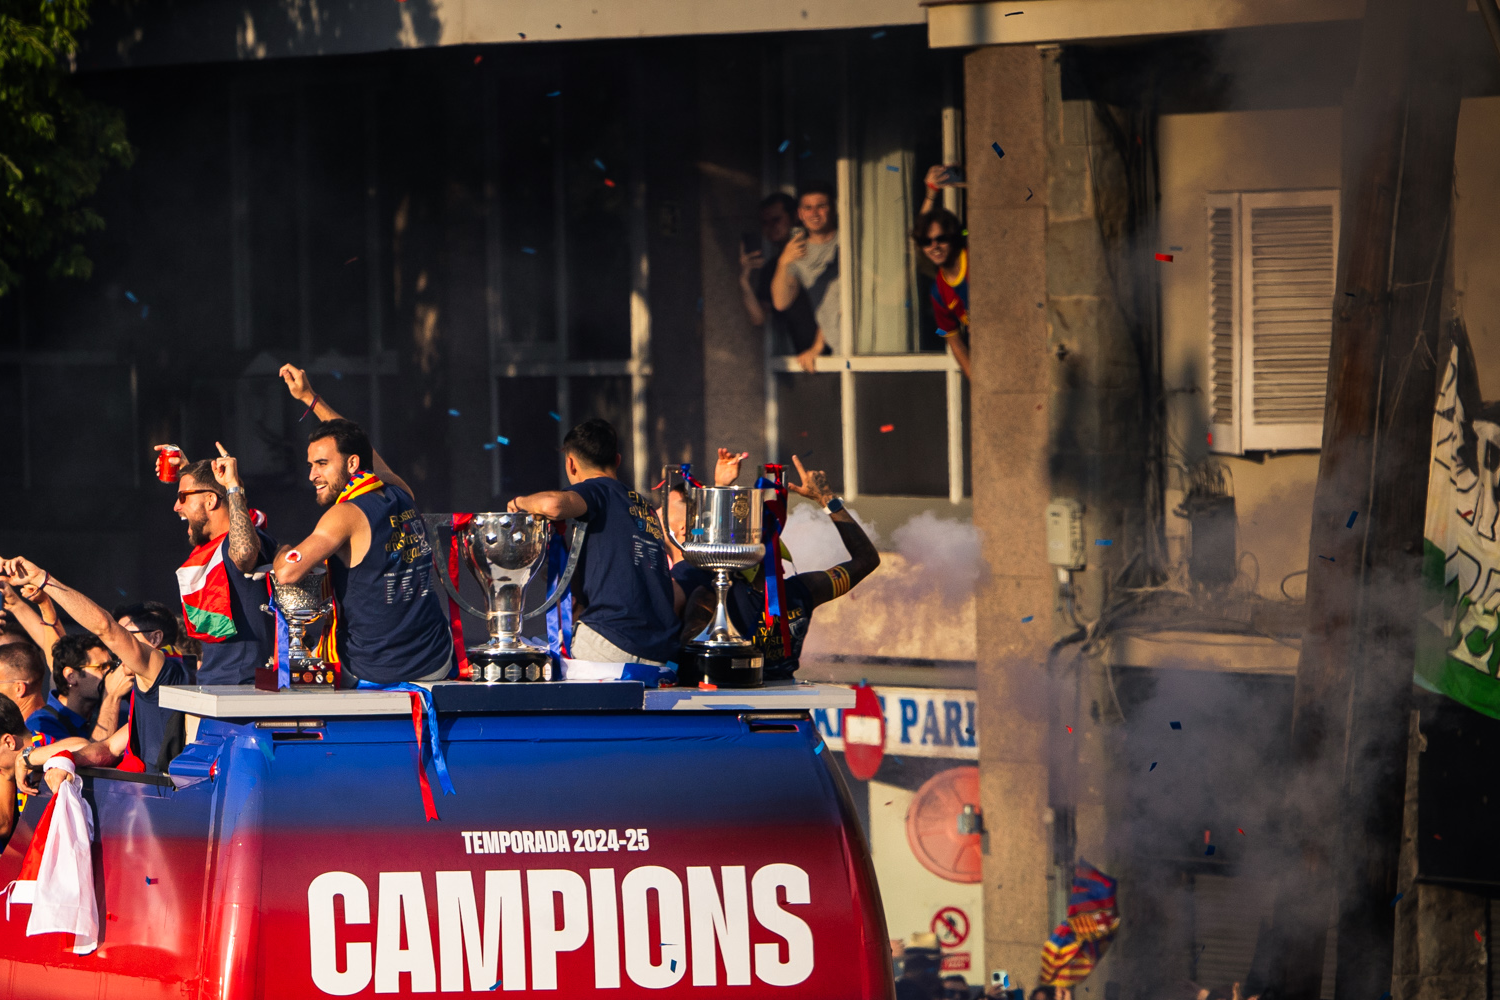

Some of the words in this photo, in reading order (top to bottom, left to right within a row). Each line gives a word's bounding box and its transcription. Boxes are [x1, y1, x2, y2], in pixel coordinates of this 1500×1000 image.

[462, 829, 570, 854] TEMPORADA
[572, 828, 649, 853] 2024-25
[308, 863, 814, 996] CAMPIONS
